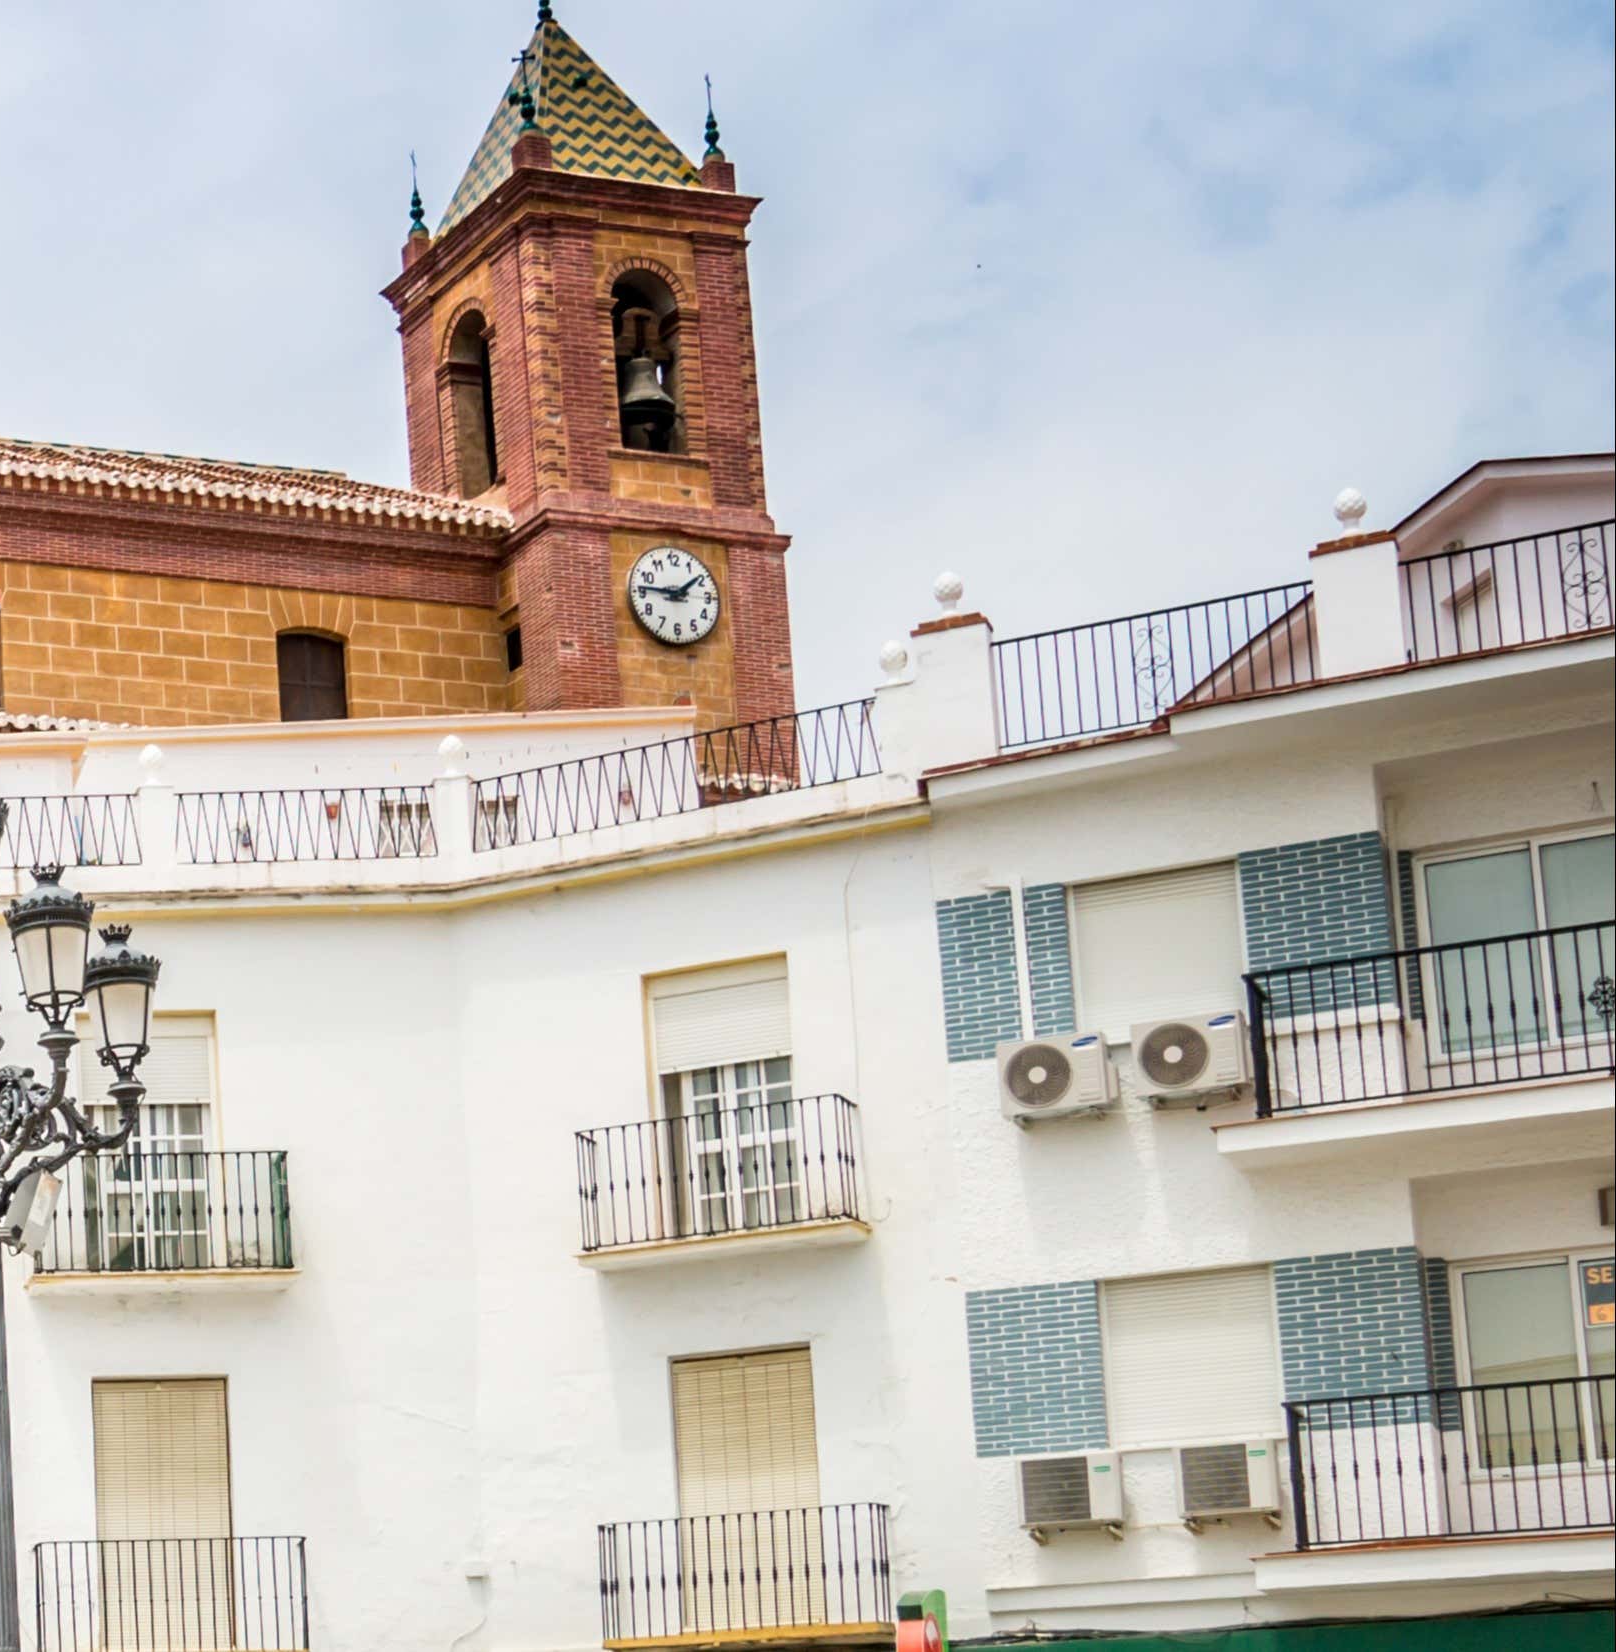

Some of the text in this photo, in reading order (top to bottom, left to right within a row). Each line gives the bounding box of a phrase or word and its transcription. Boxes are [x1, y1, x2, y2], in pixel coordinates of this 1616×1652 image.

[652, 559, 664, 571] 11
[667, 553, 680, 567] 12
[686, 561, 692, 574] 1
[641, 571, 654, 584] 10
[697, 574, 705, 587] 2
[704, 591, 712, 604] 3
[645, 602, 653, 616] 8
[700, 607, 708, 620] 4
[658, 615, 667, 629] 7
[690, 619, 698, 632] 5
[673, 622, 682, 636] 6
[1587, 1265, 1613, 1285] SE
